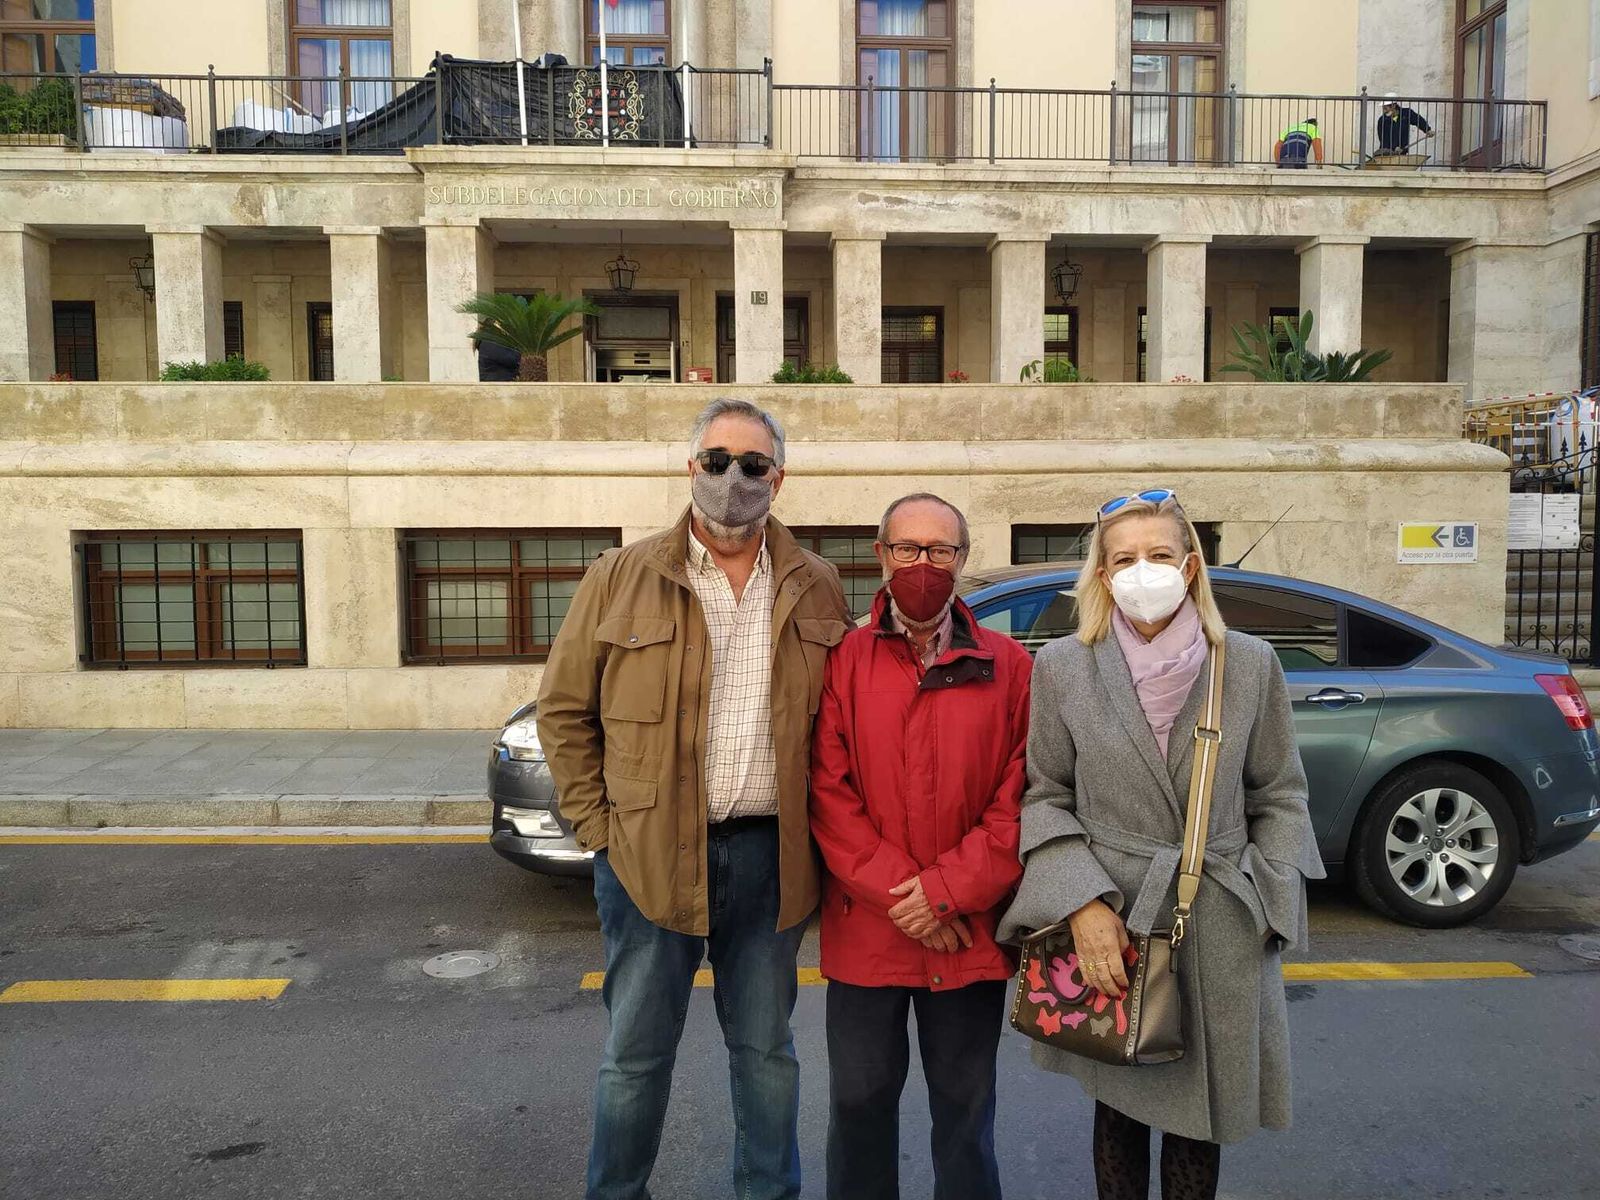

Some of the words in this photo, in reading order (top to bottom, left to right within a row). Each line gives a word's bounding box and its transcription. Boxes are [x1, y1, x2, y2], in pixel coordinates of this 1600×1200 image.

[428, 185, 608, 207] SUBDELEGACION
[617, 187, 660, 208] DEL
[669, 188, 778, 209] GOBIERNO
[753, 291, 766, 304] 19
[1454, 552, 1474, 560] puerta
